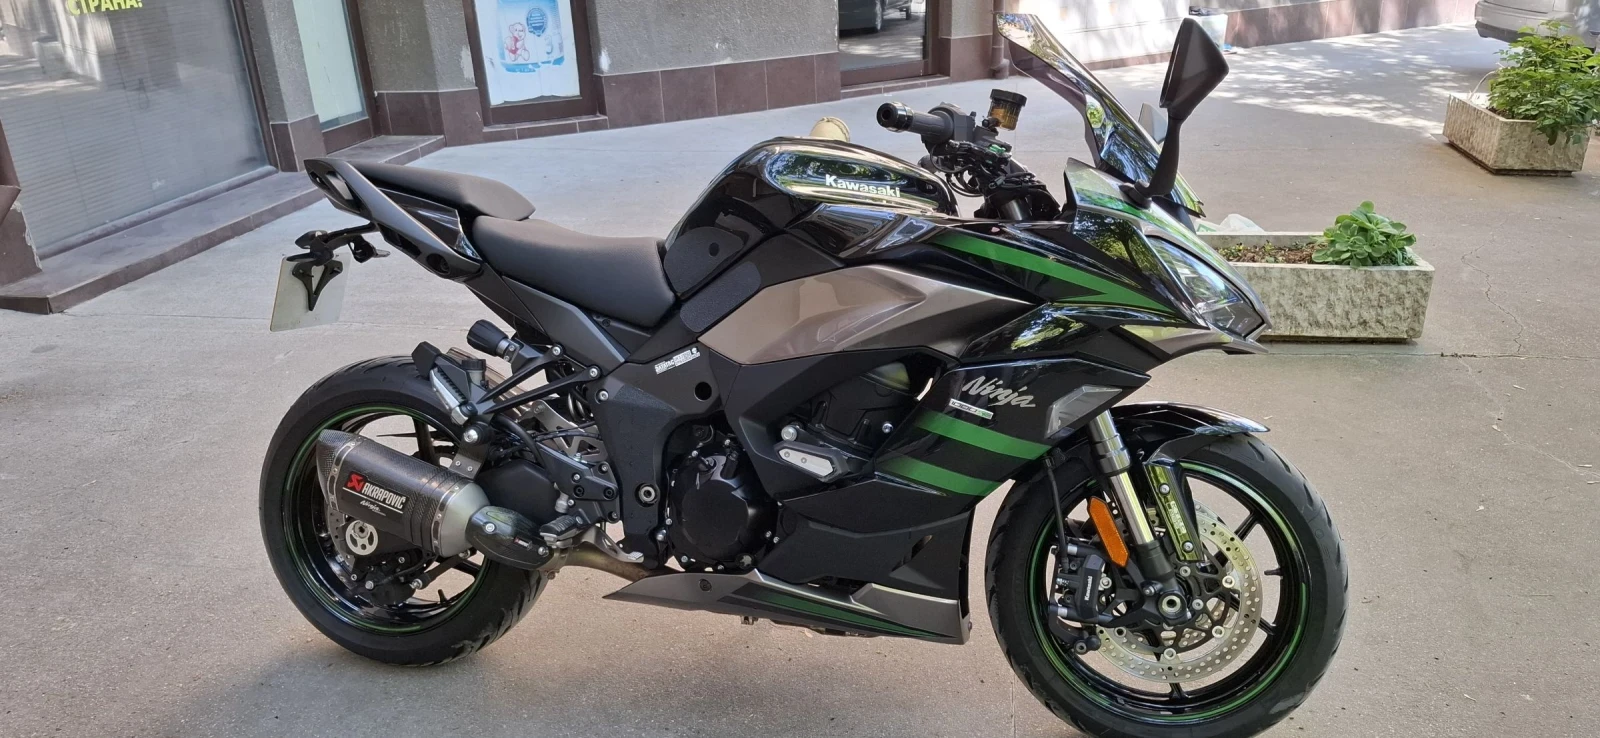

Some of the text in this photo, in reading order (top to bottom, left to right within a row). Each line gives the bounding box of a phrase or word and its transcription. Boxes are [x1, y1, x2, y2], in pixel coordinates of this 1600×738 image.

[825, 174, 901, 198] Kawasaki
[962, 375, 1036, 408] Ninja
[1084, 575, 1093, 601] Kawasaki
